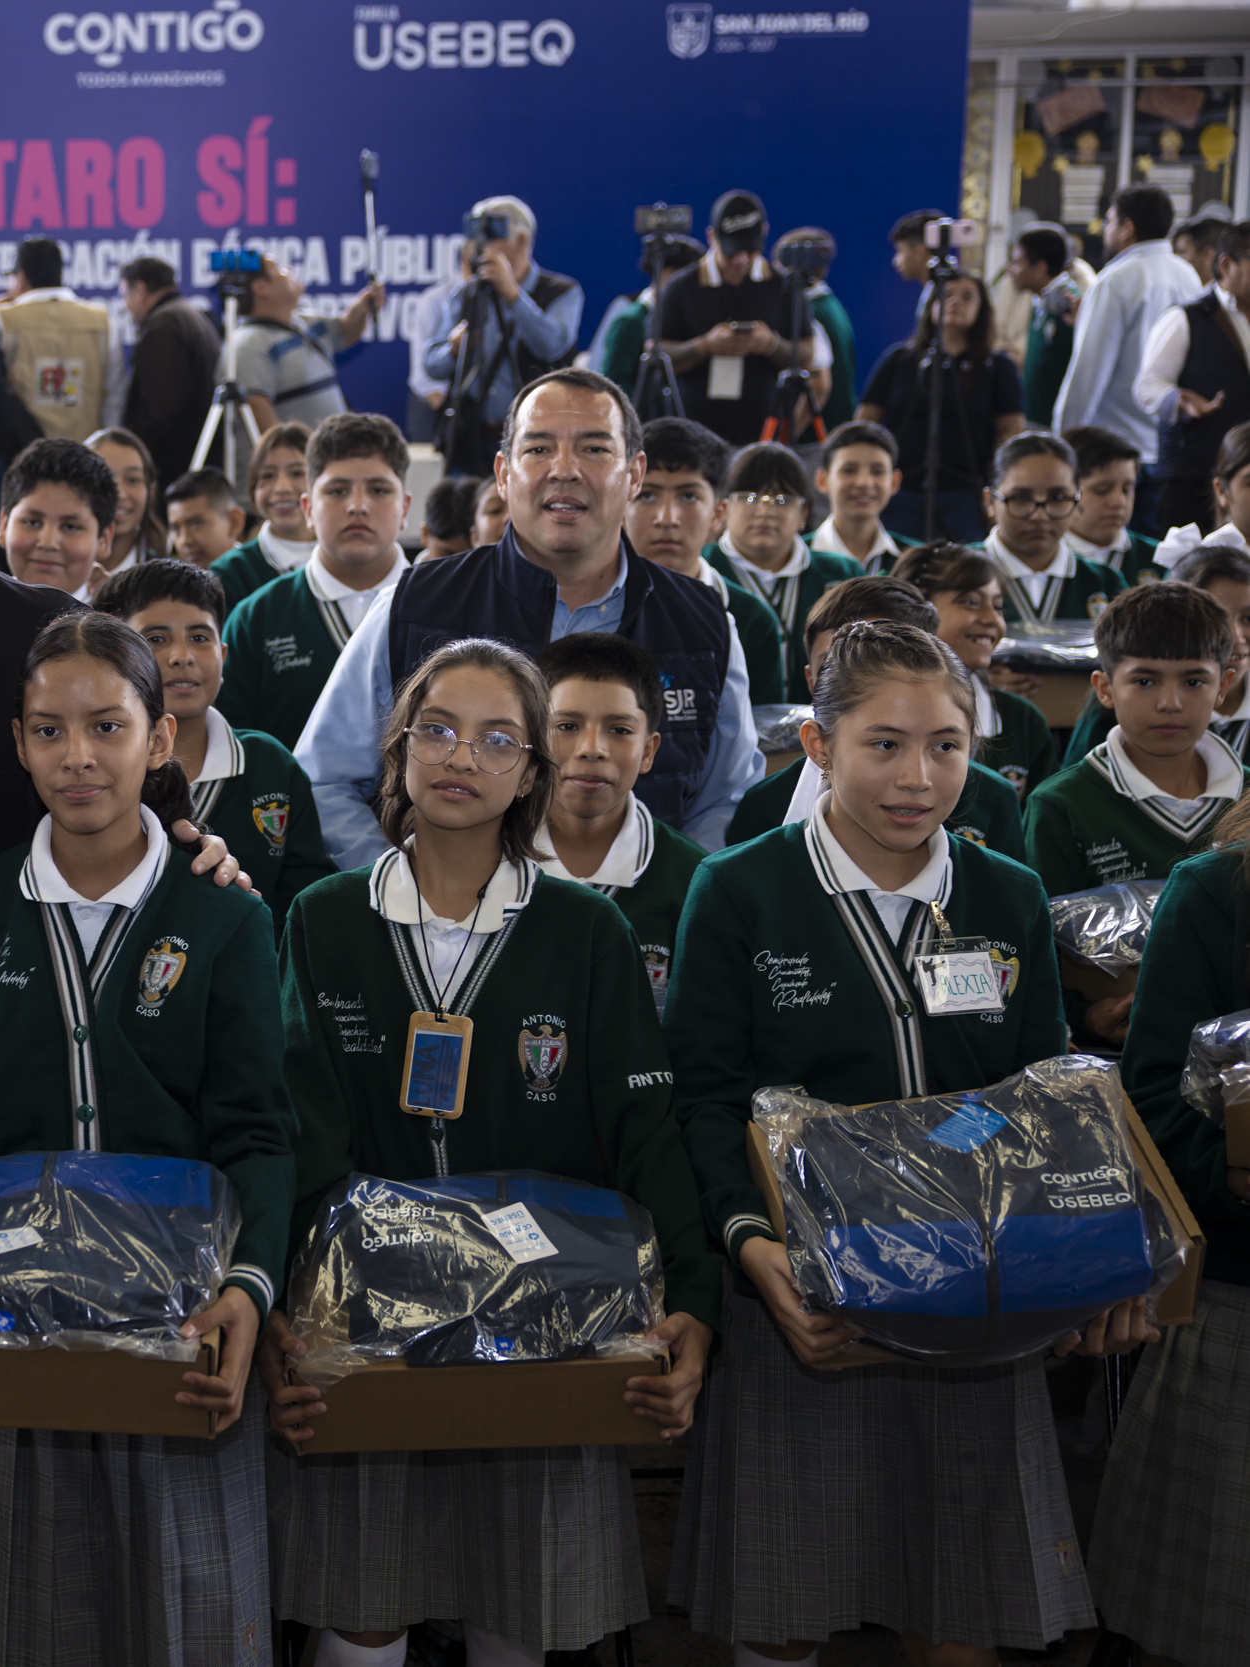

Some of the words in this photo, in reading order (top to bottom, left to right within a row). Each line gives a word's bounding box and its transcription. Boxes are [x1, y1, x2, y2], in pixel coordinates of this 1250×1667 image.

[43, 0, 265, 68] CONTIGO
[352, 18, 576, 71] USEBEQ
[196, 116, 297, 228] SÍ:
[663, 688, 696, 715] SJR
[154, 935, 189, 951] ANTONIO
[974, 941, 1017, 954] ANTONIO
[939, 973, 993, 995] ALEXIA
[136, 1005, 160, 1017] CASO
[980, 1012, 1004, 1023] CASO
[522, 1014, 566, 1028] ANTONIO
[409, 1044, 441, 1106] LUNA
[526, 1090, 557, 1102] CASO
[1040, 1165, 1121, 1188] CONTIGO
[1049, 1192, 1132, 1209] USEBEQ
[361, 1206, 435, 1221] USEBEQ
[361, 1229, 435, 1252] CONTIGO
